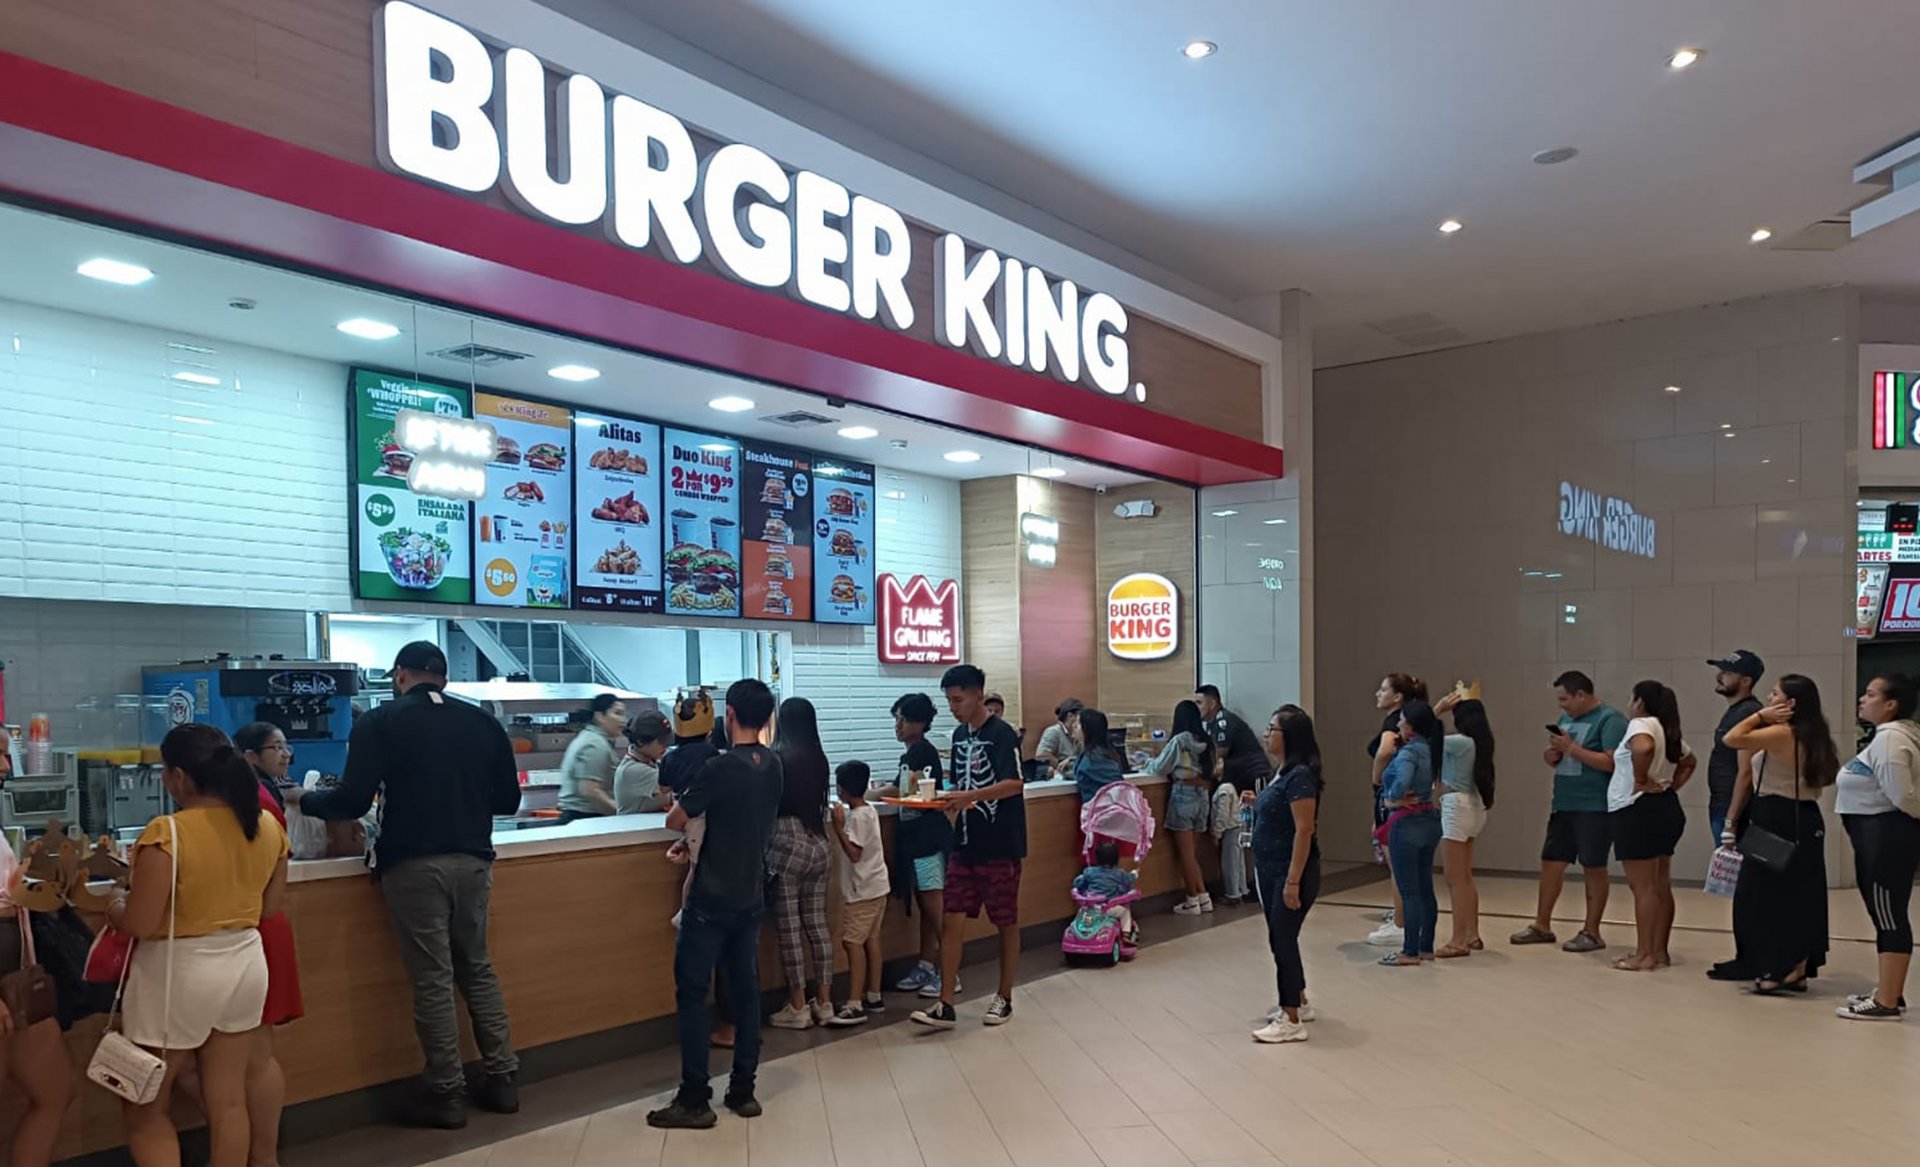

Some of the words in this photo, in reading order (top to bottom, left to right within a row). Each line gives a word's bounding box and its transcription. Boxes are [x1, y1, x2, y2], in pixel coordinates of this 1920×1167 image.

[377, 0, 916, 331] BURGER
[938, 232, 1147, 402] KING.
[598, 423, 642, 444] Alitas
[672, 445, 699, 464] Duo
[700, 449, 732, 473] King
[671, 466, 684, 489] 2
[686, 481, 703, 492] POR
[703, 473, 734, 494] $999
[417, 499, 465, 511] ENSALADA
[417, 508, 465, 521] ITALIANA
[1858, 551, 1892, 561] ARTES
[901, 606, 944, 627] FLAME
[1109, 602, 1171, 617] BURGER
[894, 627, 952, 648] GRILLING
[1109, 618, 1172, 639] KING
